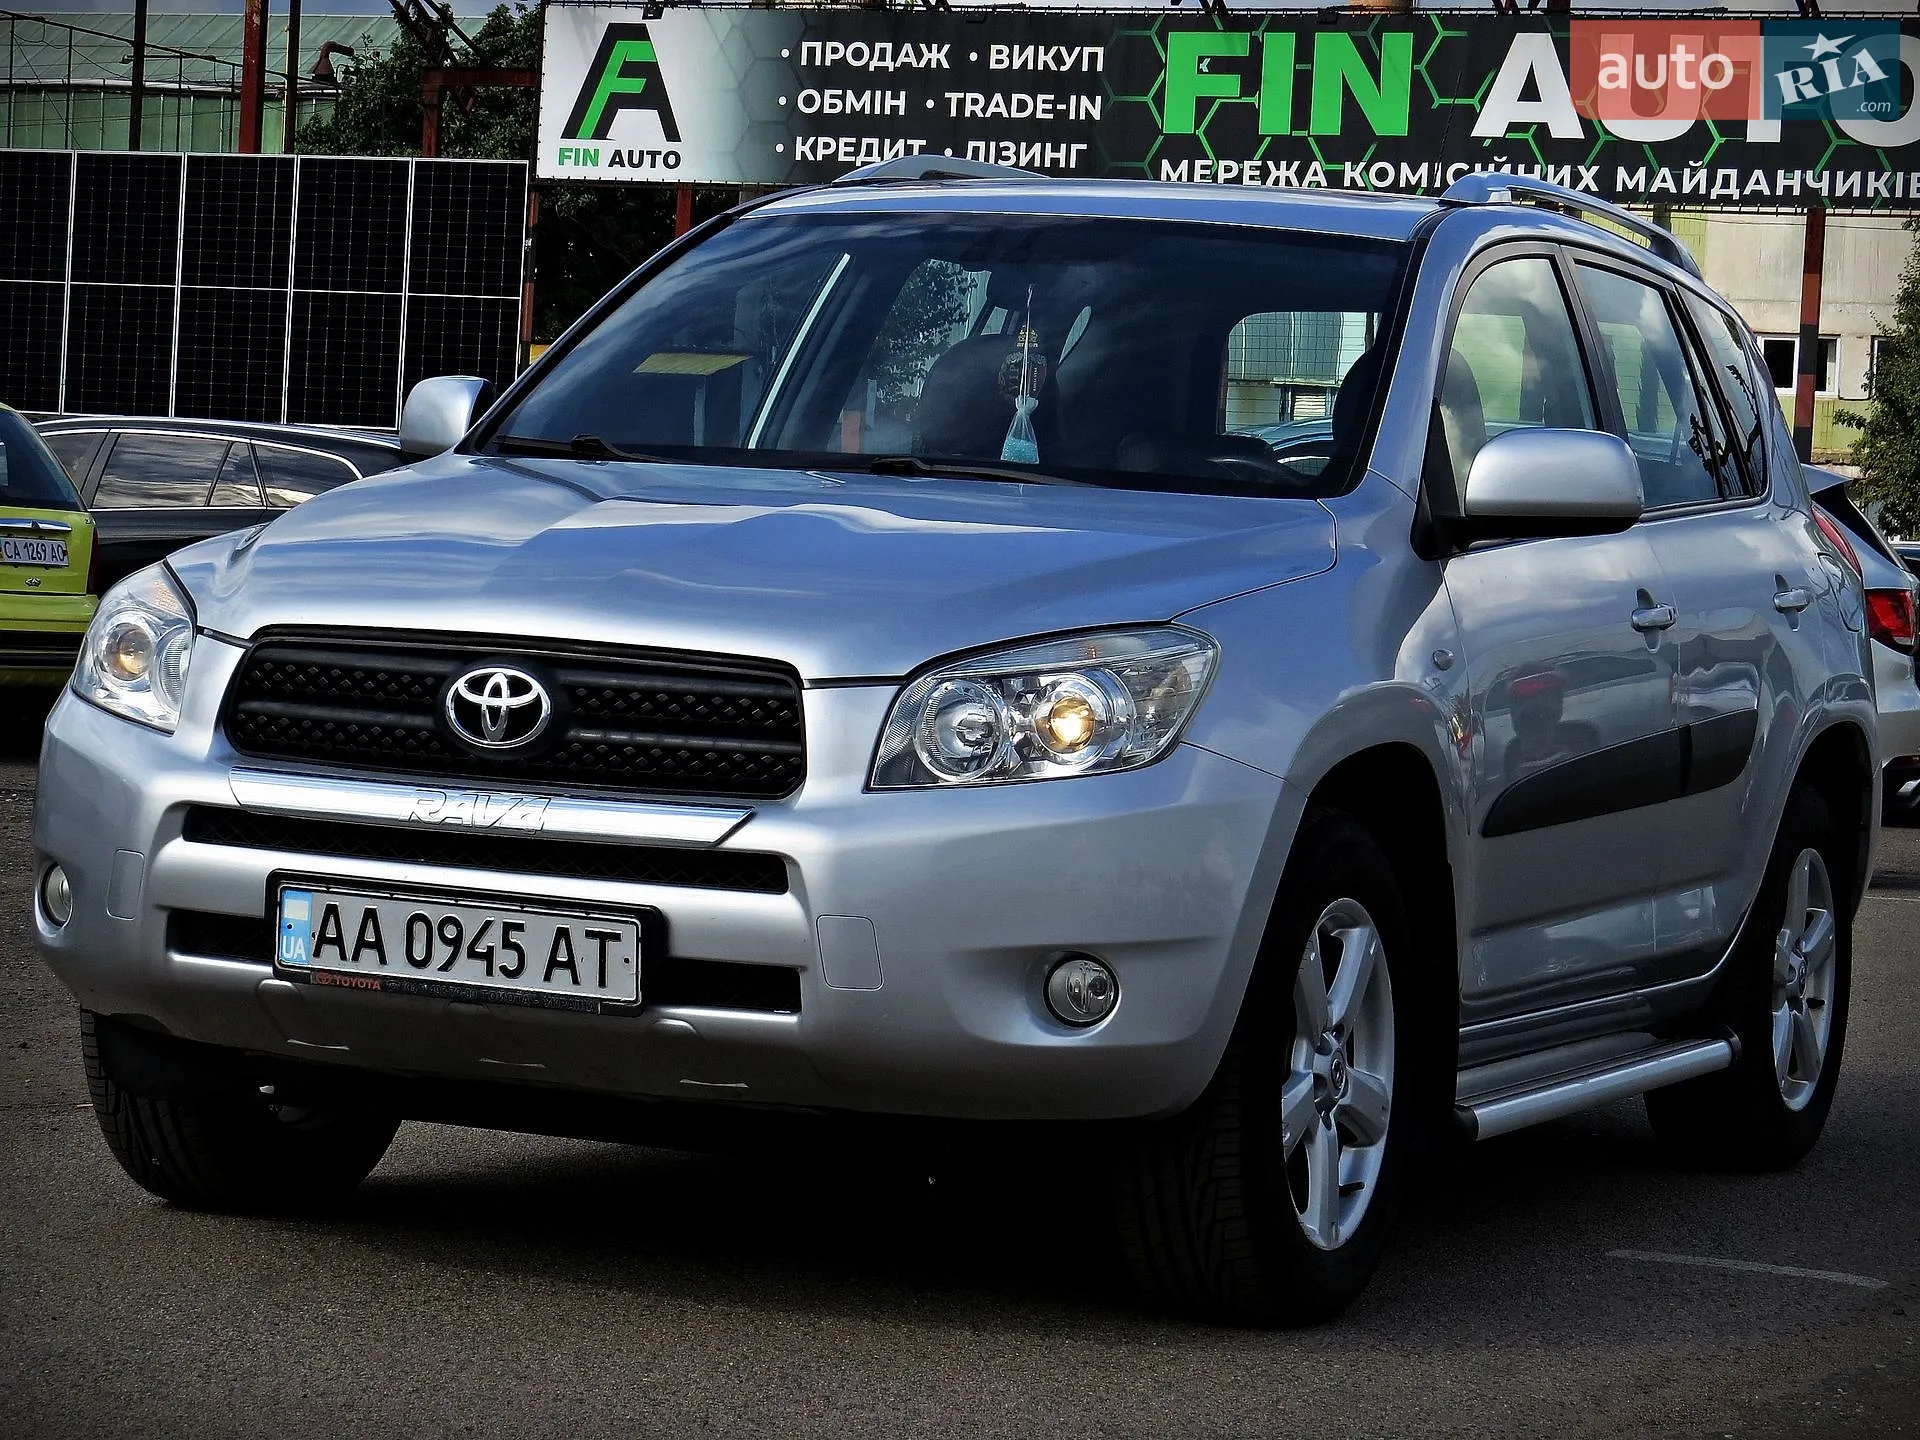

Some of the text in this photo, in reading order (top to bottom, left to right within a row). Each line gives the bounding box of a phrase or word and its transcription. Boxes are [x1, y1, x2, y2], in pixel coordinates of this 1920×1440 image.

[799, 41, 1104, 73] ПРОДАЖ ВИКУП
[1162, 32, 1920, 147] FIN AUTO
[798, 90, 1102, 121] ОБМІН TRADE-IN
[558, 147, 682, 170] FIN AUTO
[795, 136, 1088, 169] КРЕДИТ ЛІЗИНГ
[1160, 158, 1327, 188] МЕРЕЖА
[4, 541, 21, 560] CA
[24, 542, 47, 561] 1269
[401, 788, 552, 835] RAV4
[283, 936, 308, 961] UA
[312, 902, 623, 989] AA 0945 AT
[333, 974, 381, 990] TOYOTA
